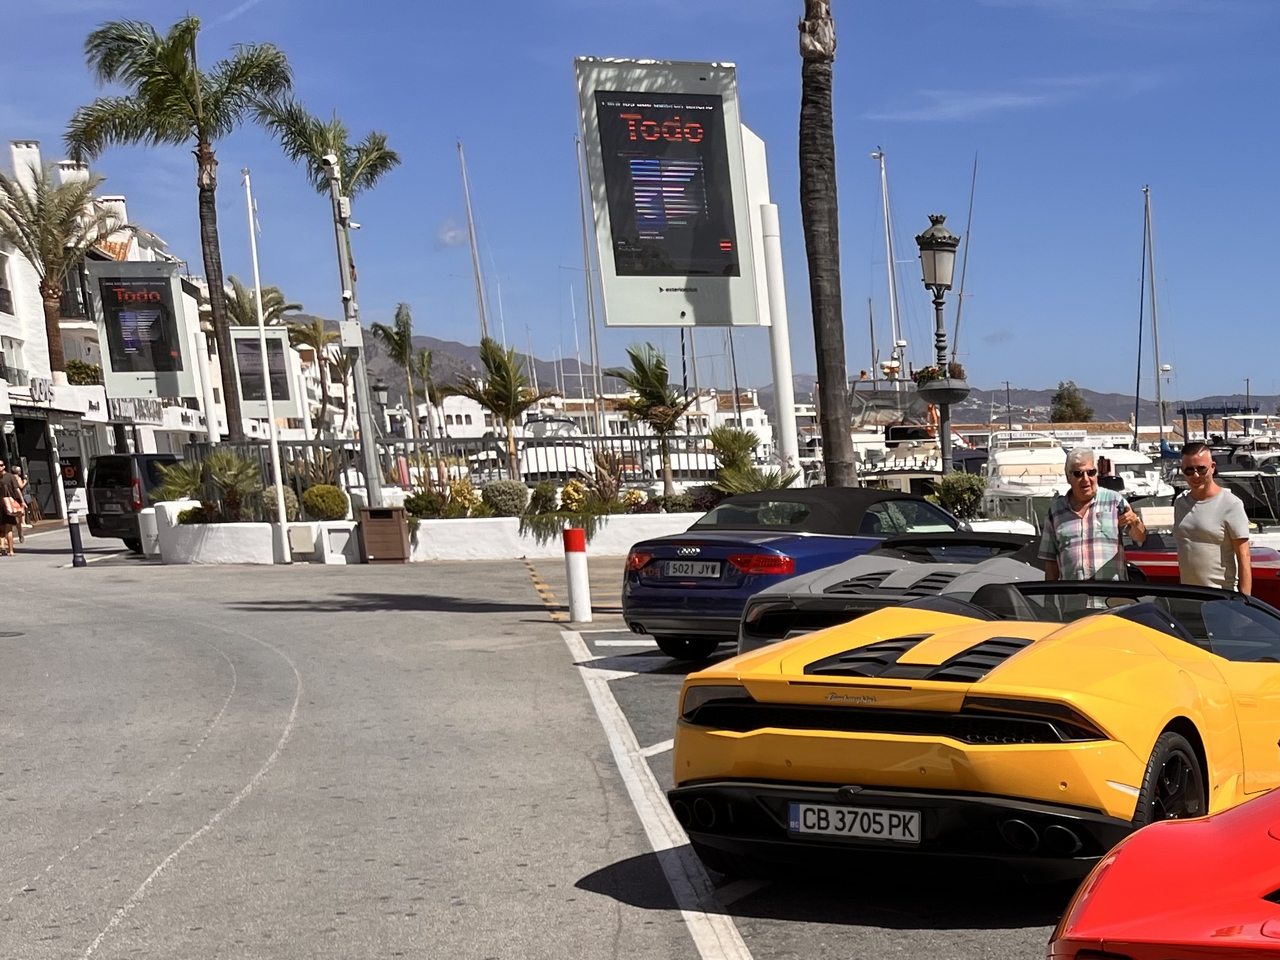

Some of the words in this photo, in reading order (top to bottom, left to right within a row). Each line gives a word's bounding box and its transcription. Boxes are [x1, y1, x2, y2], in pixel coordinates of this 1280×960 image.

[620, 113, 704, 143] Todo
[112, 287, 162, 303] Todo
[672, 563, 694, 575] 5021
[825, 692, 877, 704] Lamborghini
[803, 807, 830, 831] CB
[834, 809, 884, 835] 3705
[888, 813, 915, 838] PK
